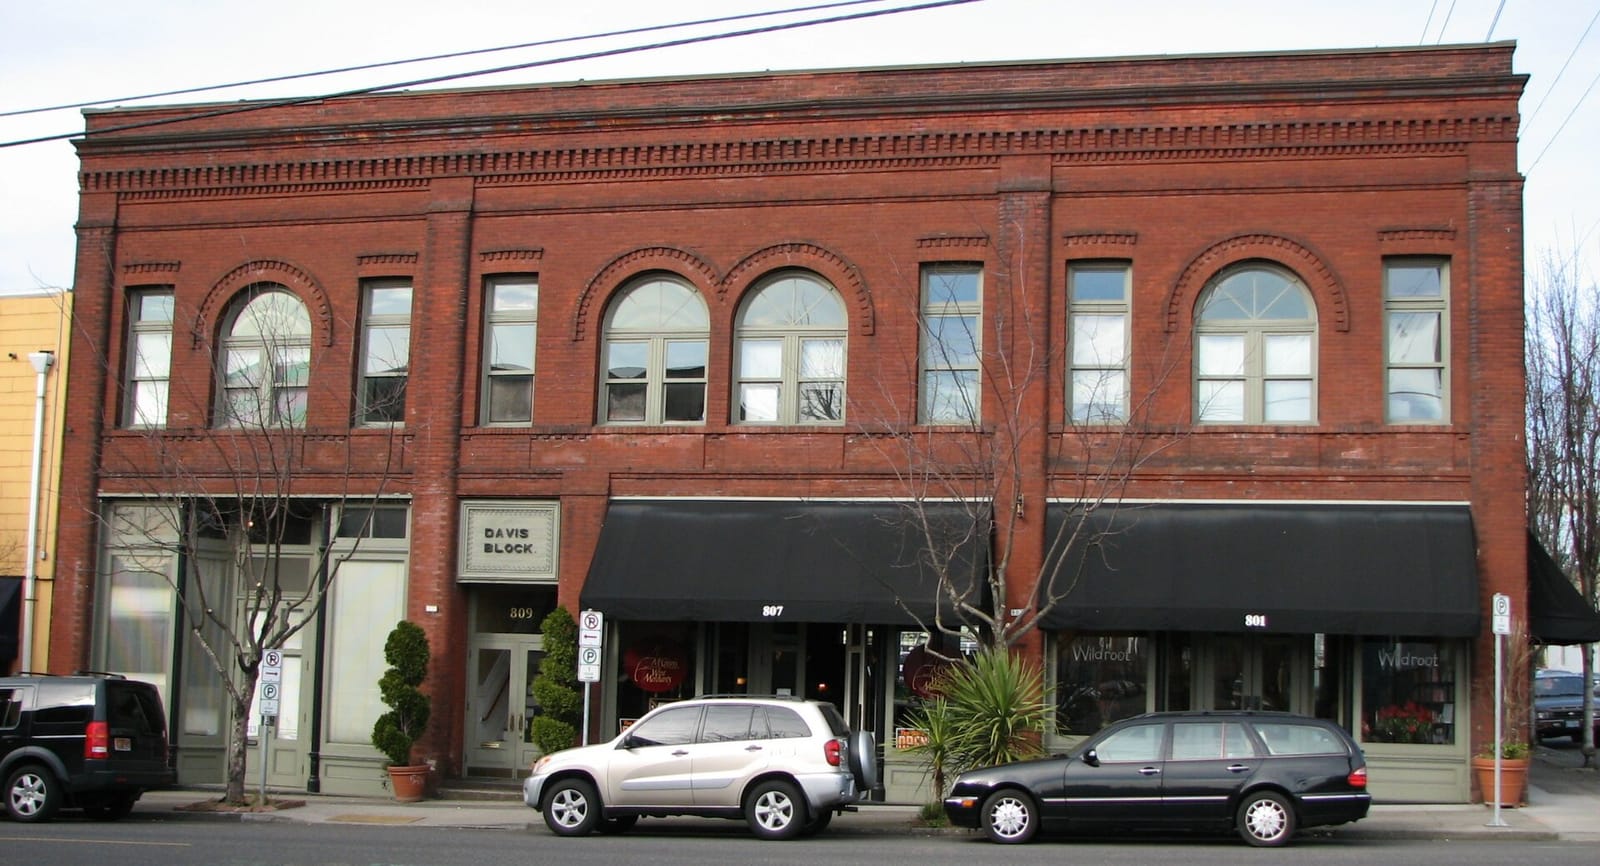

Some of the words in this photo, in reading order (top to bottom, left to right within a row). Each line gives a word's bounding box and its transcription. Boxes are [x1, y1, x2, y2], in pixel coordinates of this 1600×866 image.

[484, 528, 529, 539] DAVIS
[510, 608, 533, 619] 809
[762, 605, 783, 617] 807
[1245, 614, 1266, 627] 801
[1072, 645, 1131, 662] Wildroot
